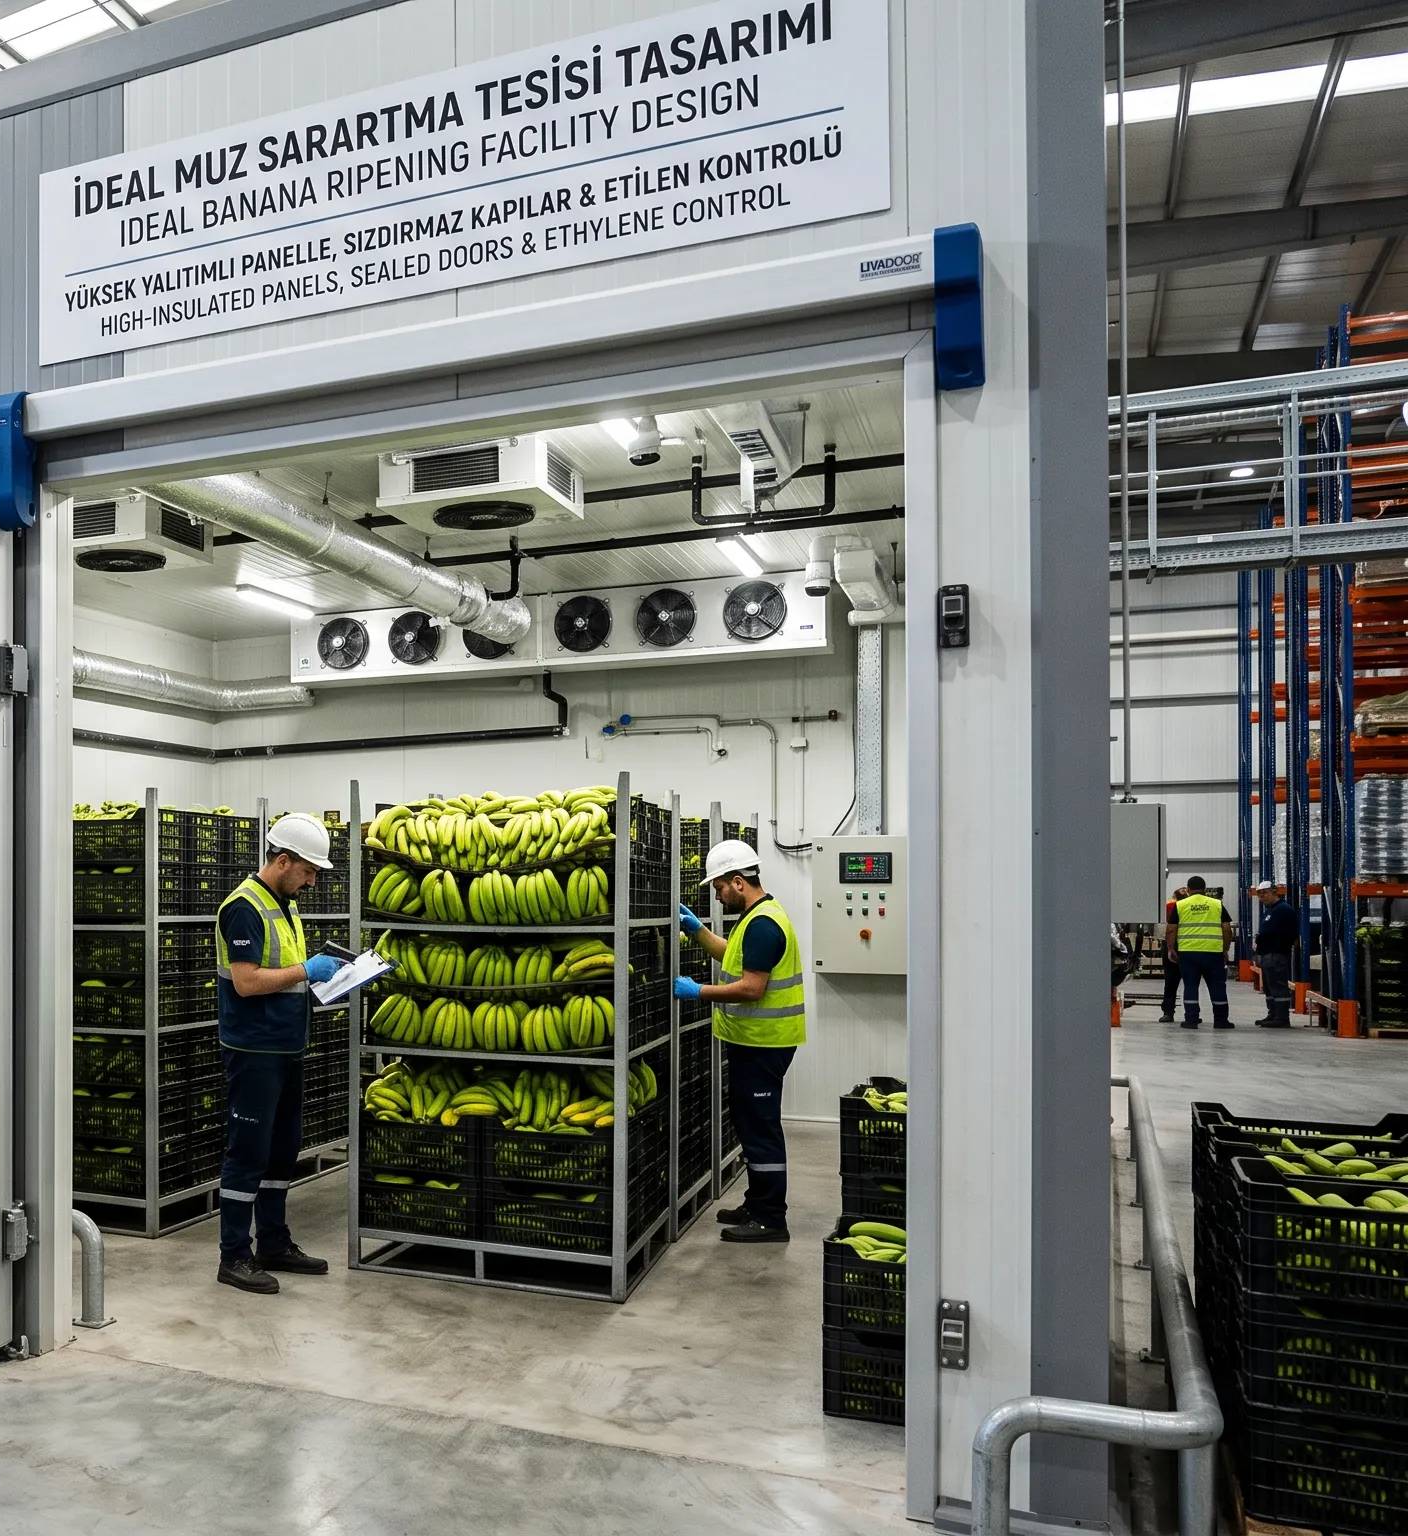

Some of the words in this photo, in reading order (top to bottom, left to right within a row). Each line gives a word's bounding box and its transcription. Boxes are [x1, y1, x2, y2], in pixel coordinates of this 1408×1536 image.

[64, 278, 137, 312] YÜKSEK
[141, 257, 235, 297] YALITIMLI
[241, 237, 337, 277] PANELLE,
[343, 209, 464, 255] SIZDIRMAZ
[471, 188, 572, 230] KAPILAR
[579, 182, 596, 208] &
[604, 162, 690, 203] ETİLEN
[699, 124, 842, 184] KONTROLÜ
[74, 165, 165, 218] İDEAL
[175, 142, 248, 194] MUZ
[258, 90, 465, 173] SARARTMA
[474, 44, 602, 121] TESİSİ
[120, 205, 194, 248] IDEAL
[202, 176, 318, 230] BANANA
[327, 140, 469, 201] RIPENING
[481, 105, 619, 167] FACILITY
[632, 74, 759, 134] DESIGN
[101, 287, 255, 337] HIGH-INSULATED
[262, 270, 344, 306] PANELS,
[350, 252, 431, 288] SEALED
[439, 236, 514, 272] DOORS
[521, 231, 537, 255] &
[545, 205, 665, 251] ETHYLENE
[672, 182, 791, 226] CONTROL
[860, 252, 921, 273] LIVADOOR
